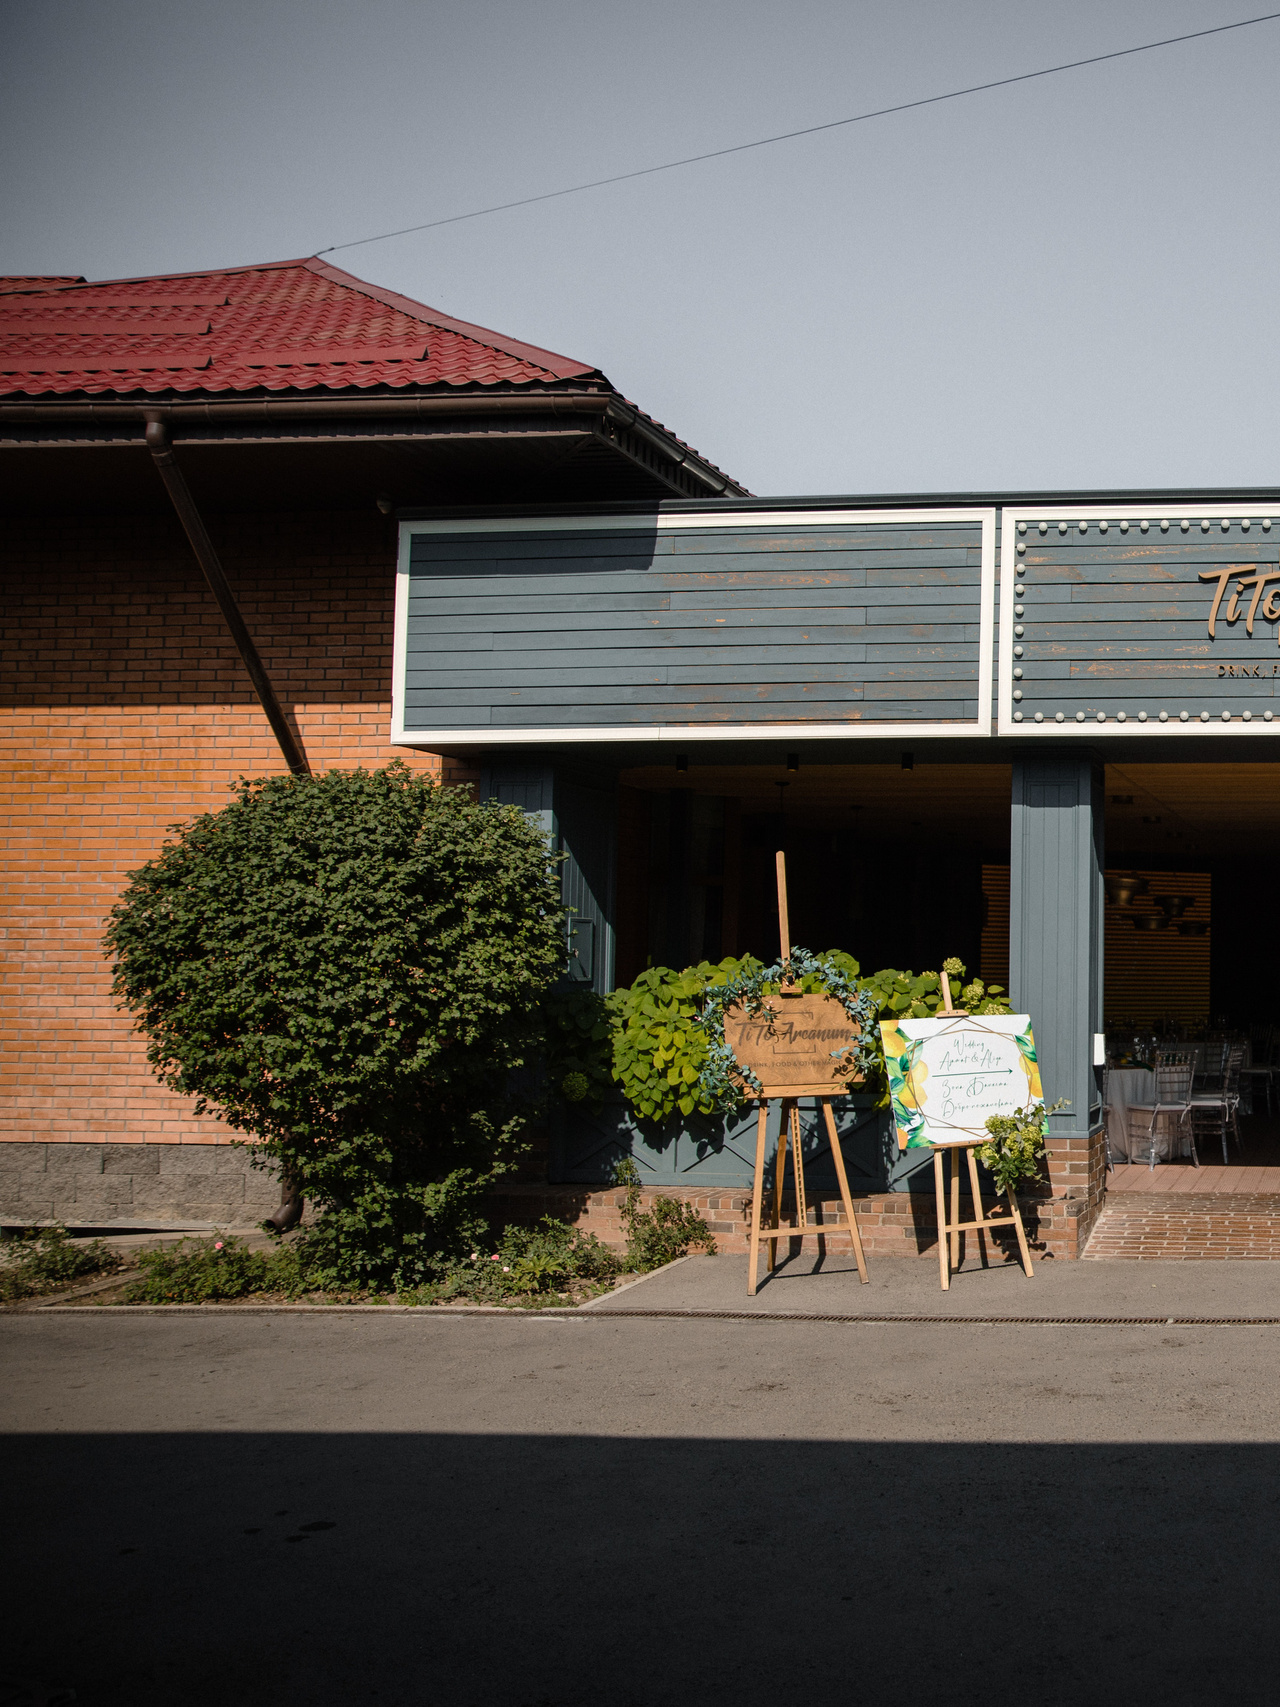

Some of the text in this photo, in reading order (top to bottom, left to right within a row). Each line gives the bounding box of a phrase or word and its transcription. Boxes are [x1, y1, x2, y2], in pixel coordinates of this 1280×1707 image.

[1218, 664, 1266, 678] DRINK,
[781, 1021, 852, 1044] Arcanum
[953, 1033, 985, 1055] Wedding
[971, 1052, 979, 1062] &
